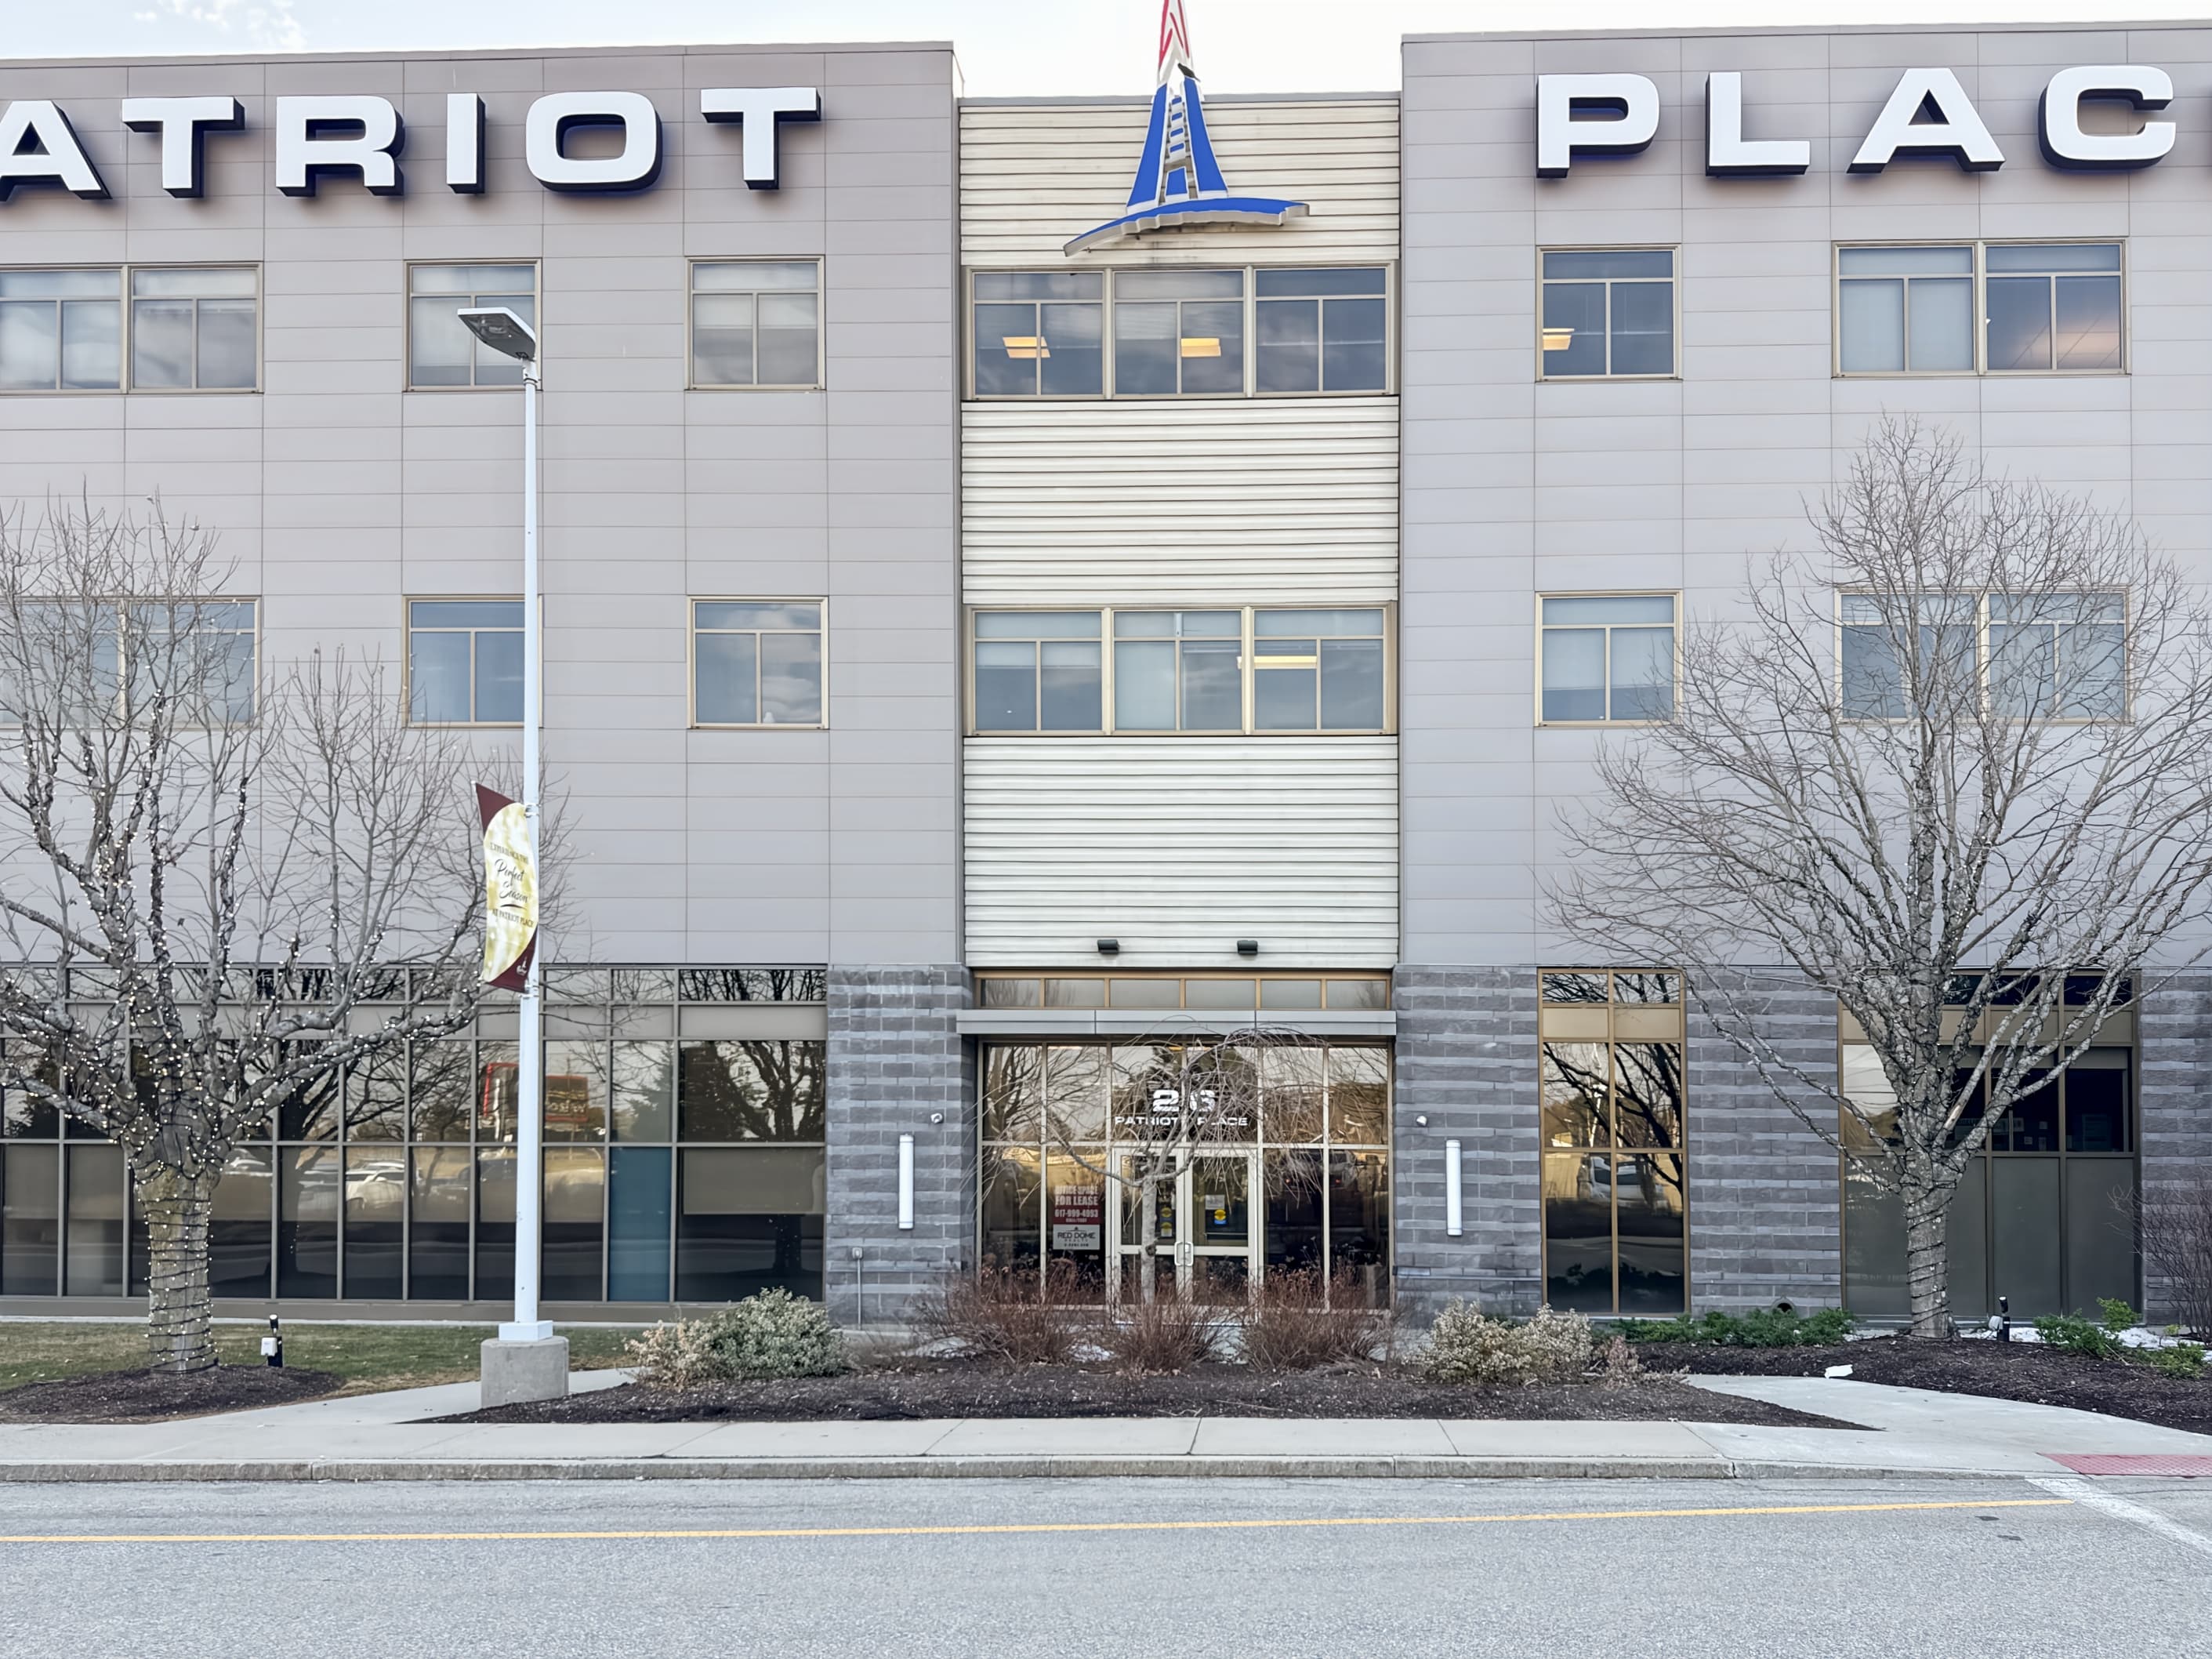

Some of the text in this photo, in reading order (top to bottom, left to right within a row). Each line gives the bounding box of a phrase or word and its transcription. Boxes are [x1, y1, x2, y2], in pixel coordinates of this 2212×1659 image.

[0, 64, 2176, 201] ATRIOT PLAC
[495, 859, 524, 886] Perfect
[499, 881, 528, 902] Season
[1152, 1090, 1216, 1112] 26
[1115, 1116, 1179, 1126] PATRIOT
[1055, 1196, 1098, 1205] FOR LEASE
